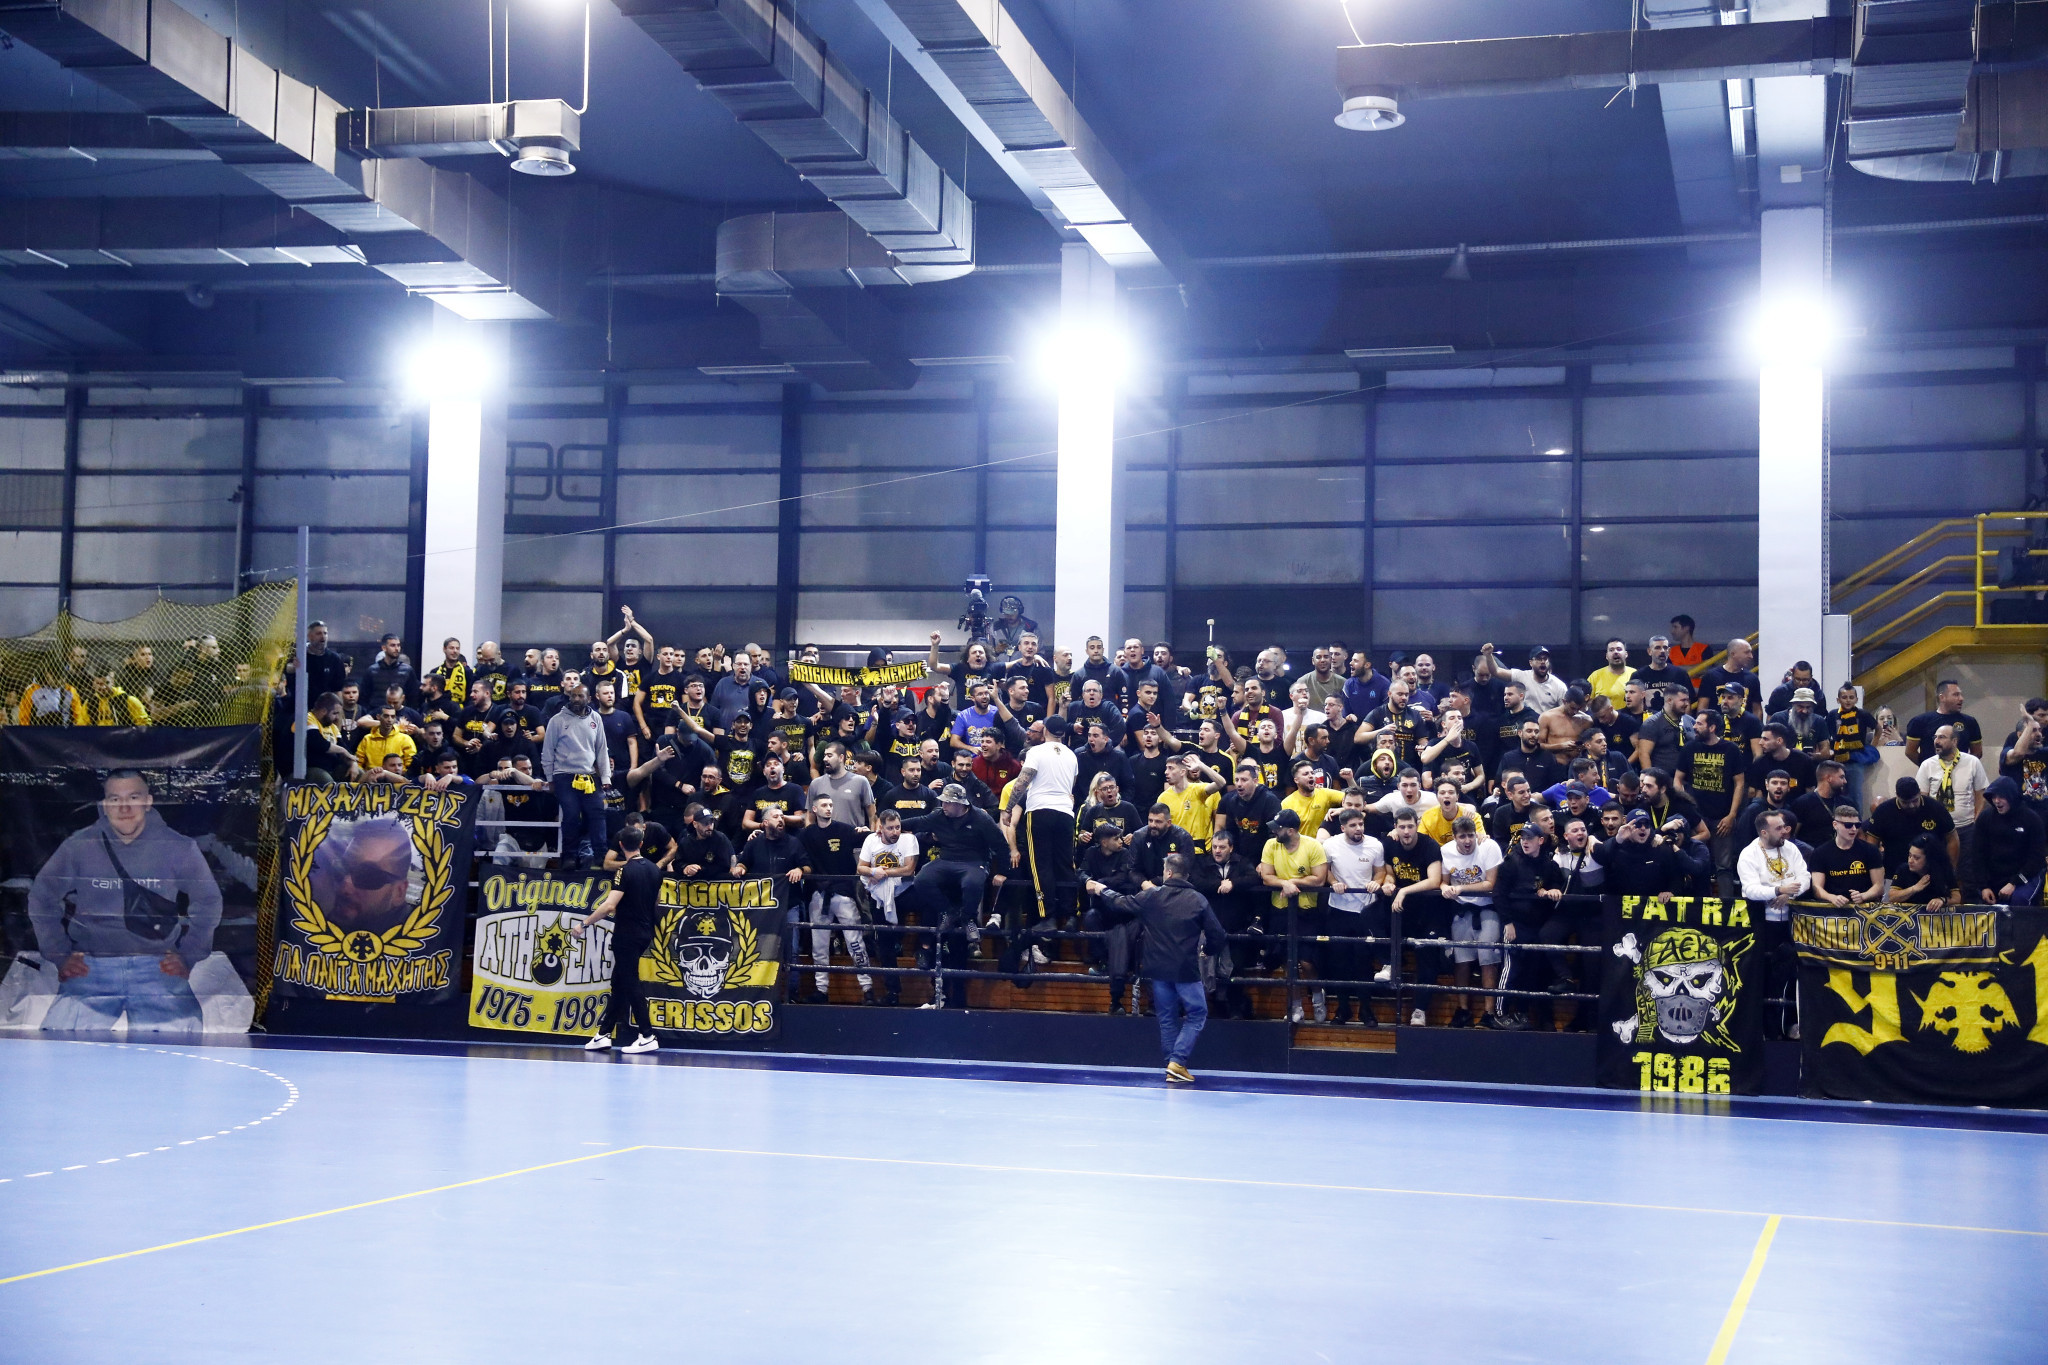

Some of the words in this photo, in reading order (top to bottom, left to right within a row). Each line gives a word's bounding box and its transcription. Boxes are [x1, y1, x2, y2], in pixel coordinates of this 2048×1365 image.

[793, 663, 850, 686] ORIGINAL
[286, 782, 393, 821] ΜΙΧΑΛΗ
[399, 786, 467, 827] ΖΕΙΣ
[483, 872, 595, 914] Original
[592, 879, 616, 917] 2
[658, 878, 780, 910] RIGINAL
[1621, 895, 1752, 928] PATRA
[274, 942, 304, 983] ΓΙΑ
[305, 953, 362, 993] ΠΑΝΤΑ
[365, 949, 453, 994] ΜΑΧΗΤΗΣ
[1873, 953, 1909, 971] 9-11
[476, 983, 534, 1028] 1975
[552, 992, 612, 1032] 1982
[629, 996, 773, 1034] ERISSOS
[1631, 1051, 1731, 1095] 1986
